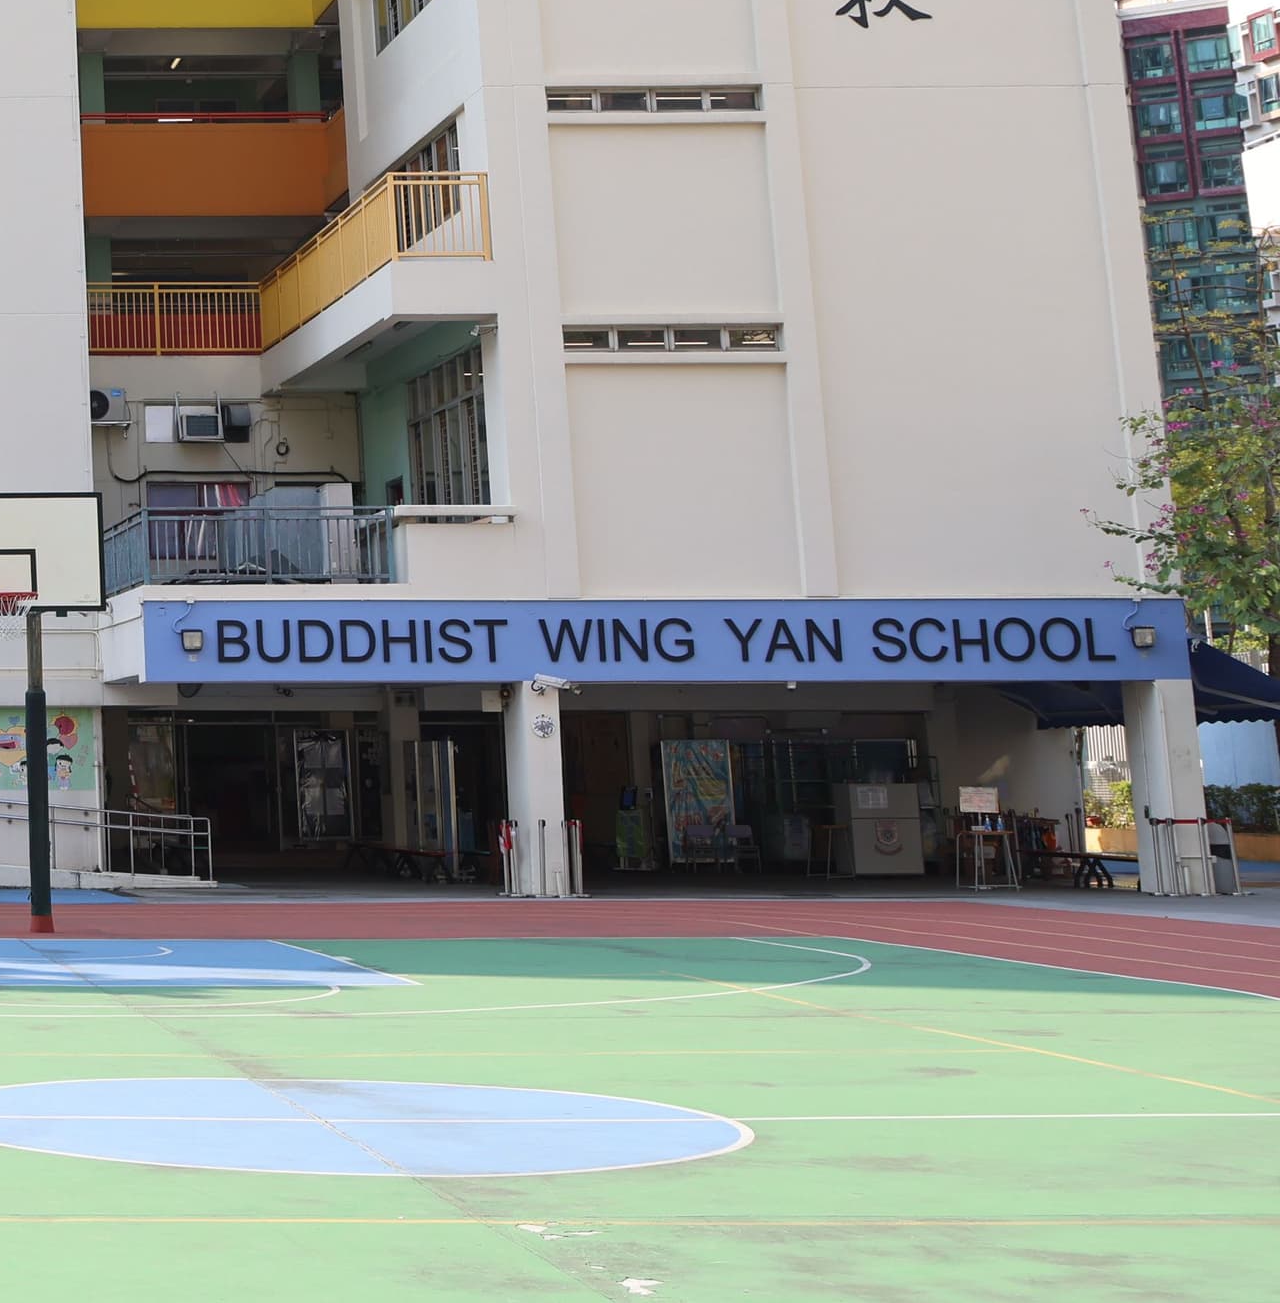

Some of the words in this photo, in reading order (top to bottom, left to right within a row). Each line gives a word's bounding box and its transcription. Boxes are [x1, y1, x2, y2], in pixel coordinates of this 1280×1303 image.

[217, 618, 508, 664] BUDDHIST
[538, 617, 696, 663] WING
[723, 617, 844, 663] YAN
[871, 617, 1117, 663] SCHOOL
